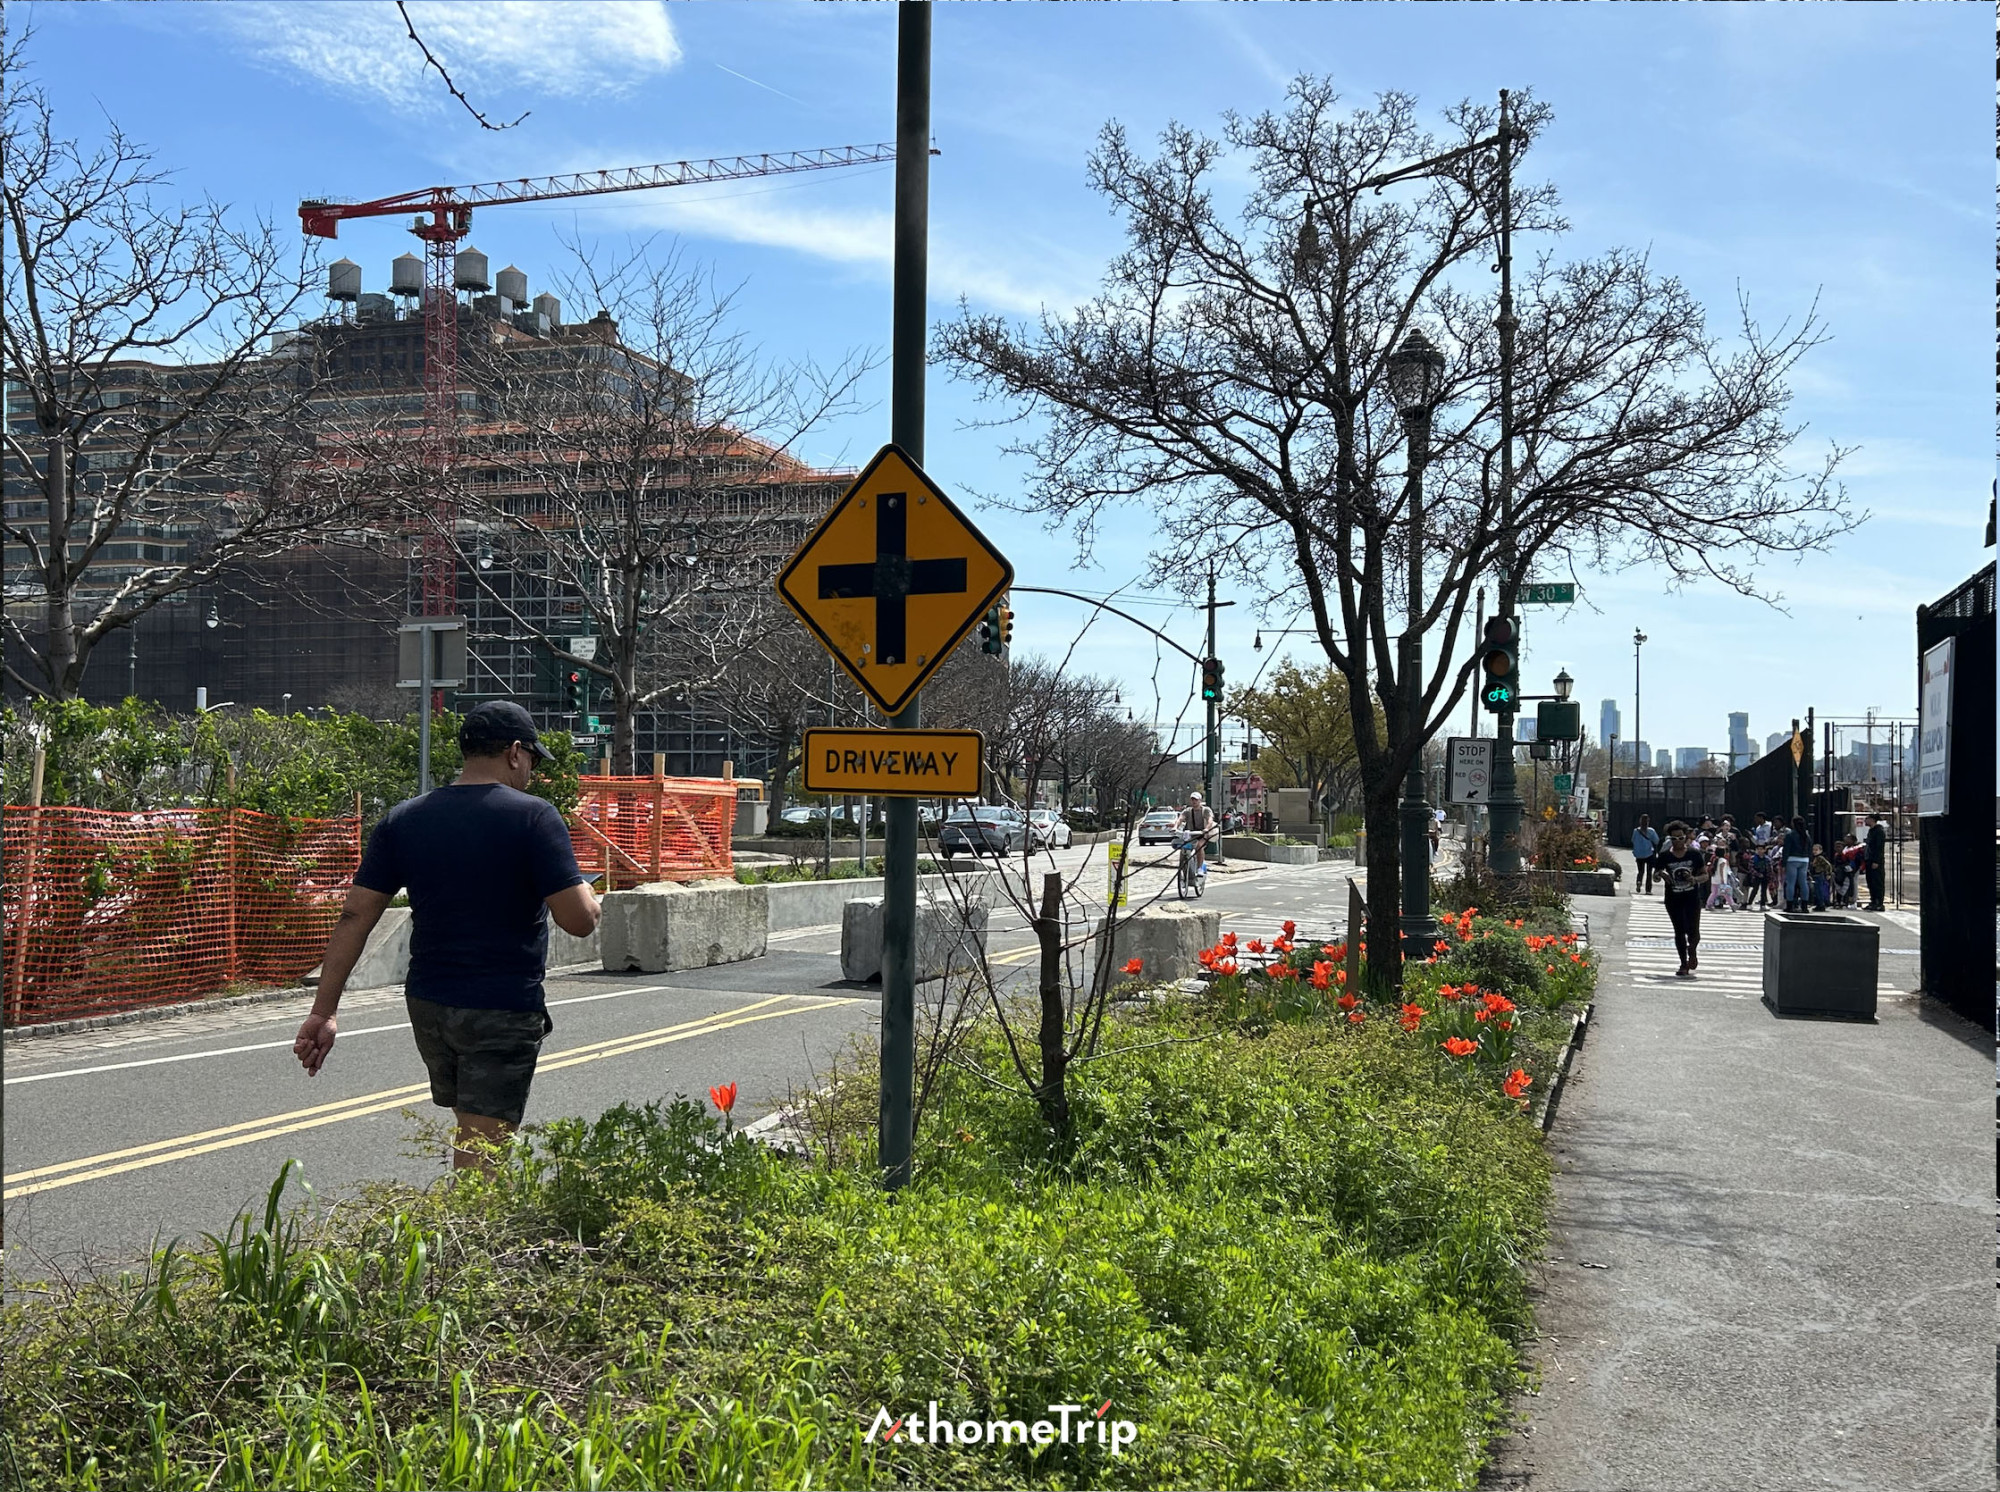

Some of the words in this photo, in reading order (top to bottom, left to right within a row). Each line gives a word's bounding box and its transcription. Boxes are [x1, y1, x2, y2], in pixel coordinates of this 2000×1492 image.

[1519, 586, 1531, 601] W
[1537, 586, 1556, 601] 30
[1458, 745, 1486, 757] STOP
[825, 749, 959, 777] DRIVEWAY
